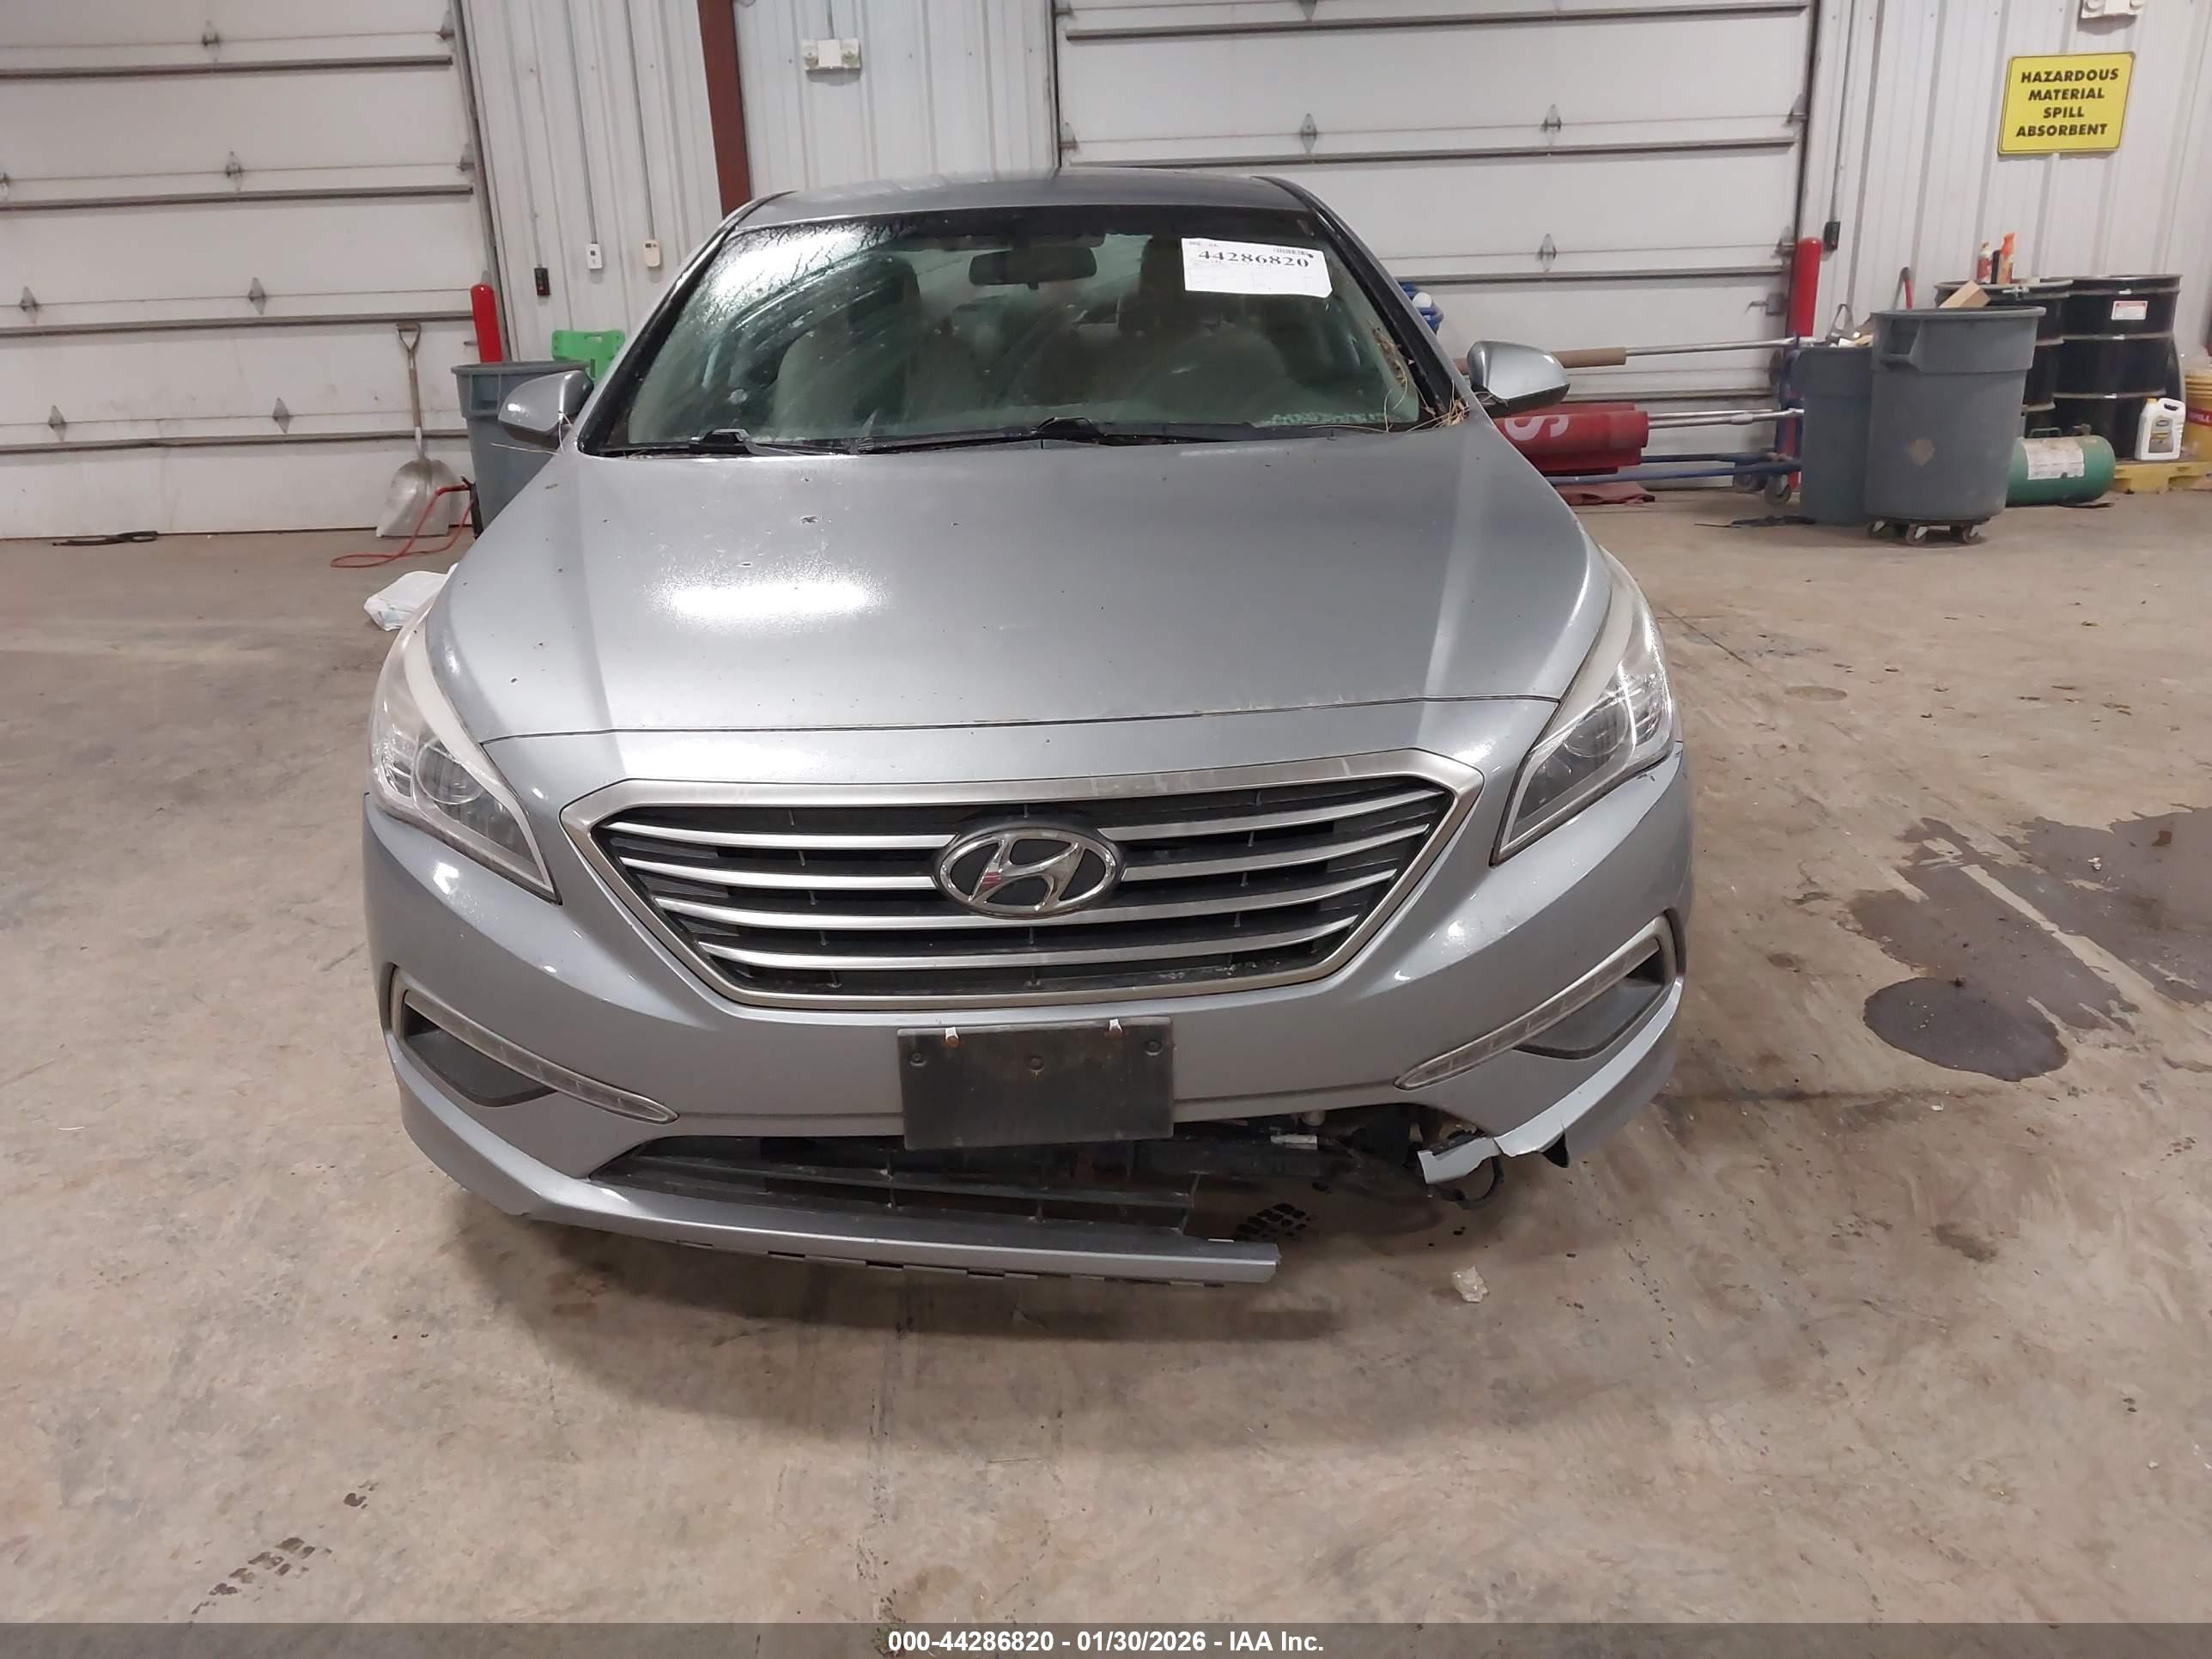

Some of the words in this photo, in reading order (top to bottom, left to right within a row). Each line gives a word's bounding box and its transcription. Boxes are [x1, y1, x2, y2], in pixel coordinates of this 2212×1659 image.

[2021, 68, 2119, 83] HAZARDOUS
[2028, 88, 2105, 101] MATERIAL
[2043, 106, 2085, 118] SPILL
[2015, 124, 2108, 137] ABSORBENT
[1198, 250, 1310, 268] 44286820
